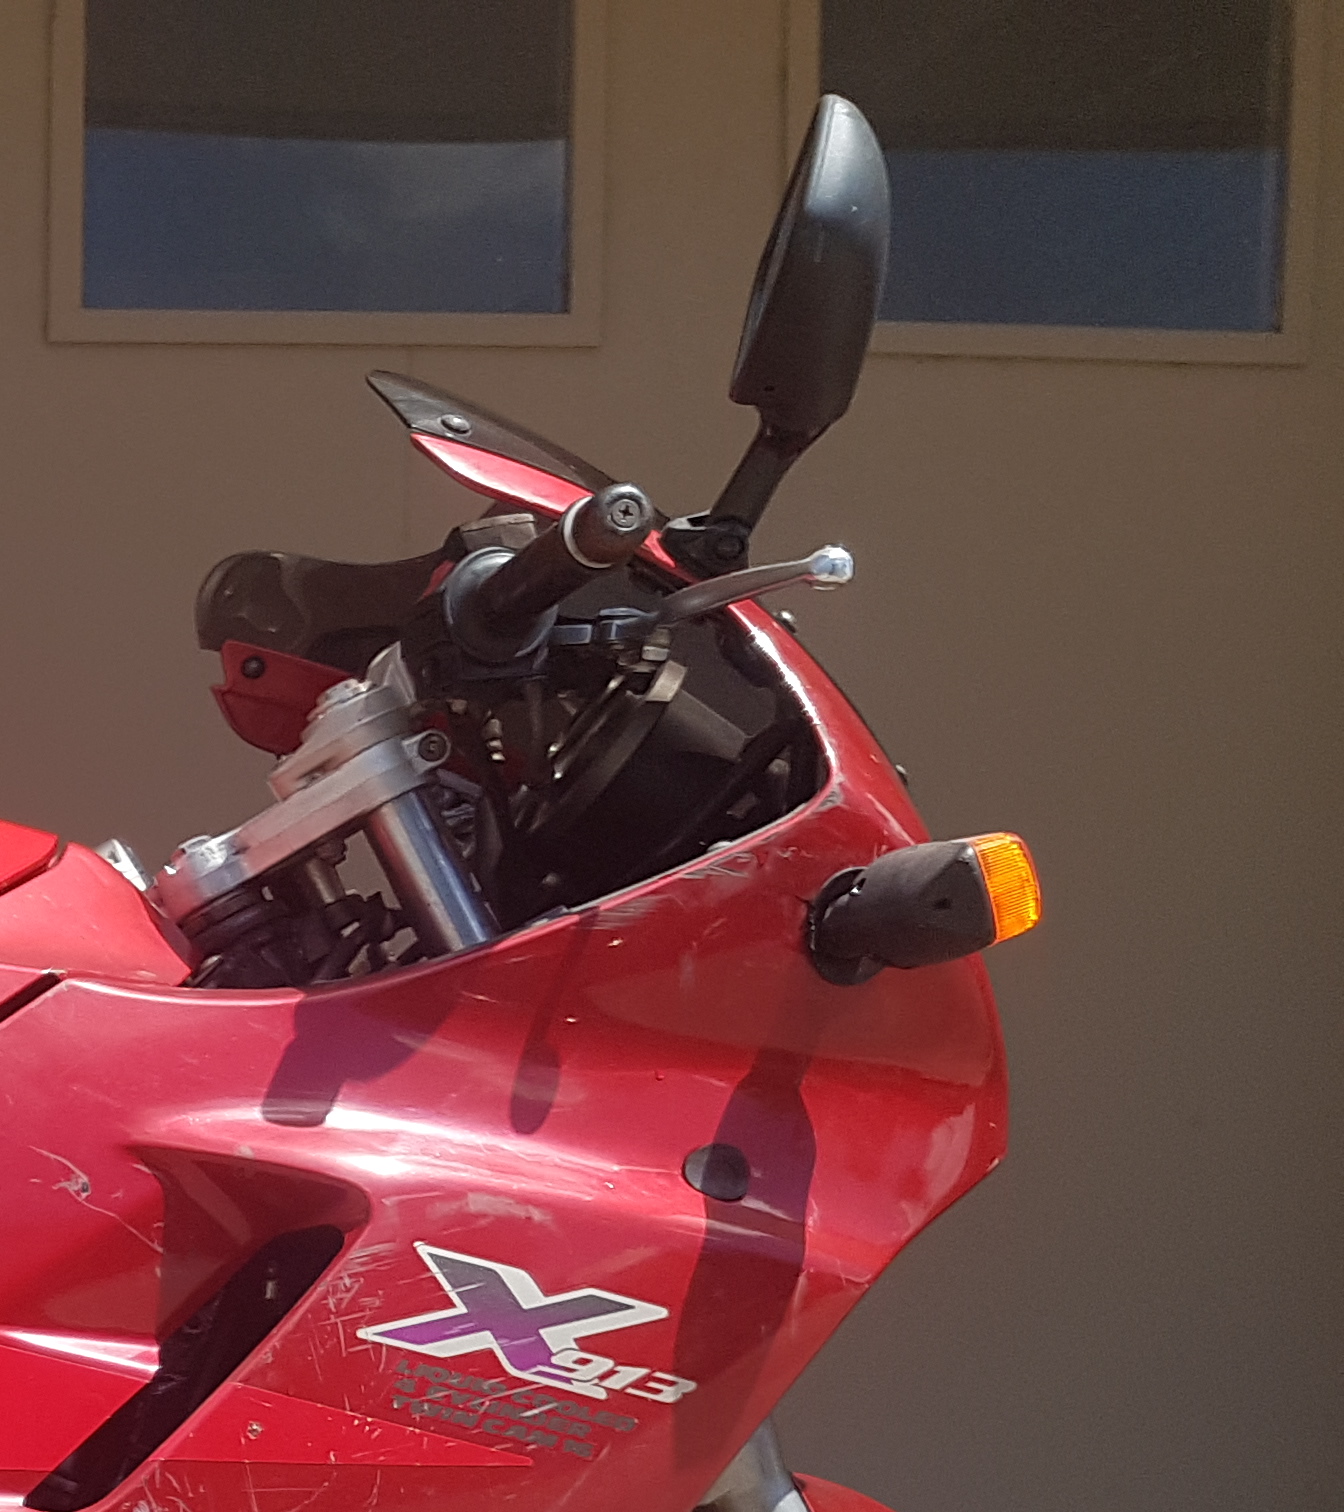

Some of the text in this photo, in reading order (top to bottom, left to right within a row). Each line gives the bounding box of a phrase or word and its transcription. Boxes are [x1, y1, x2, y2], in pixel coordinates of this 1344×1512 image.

[356, 1240, 698, 1403] X 913
[392, 1395, 480, 1428] TWIN
[481, 1418, 559, 1448] CAM
[395, 1359, 637, 1432] LIQUID COOLED
